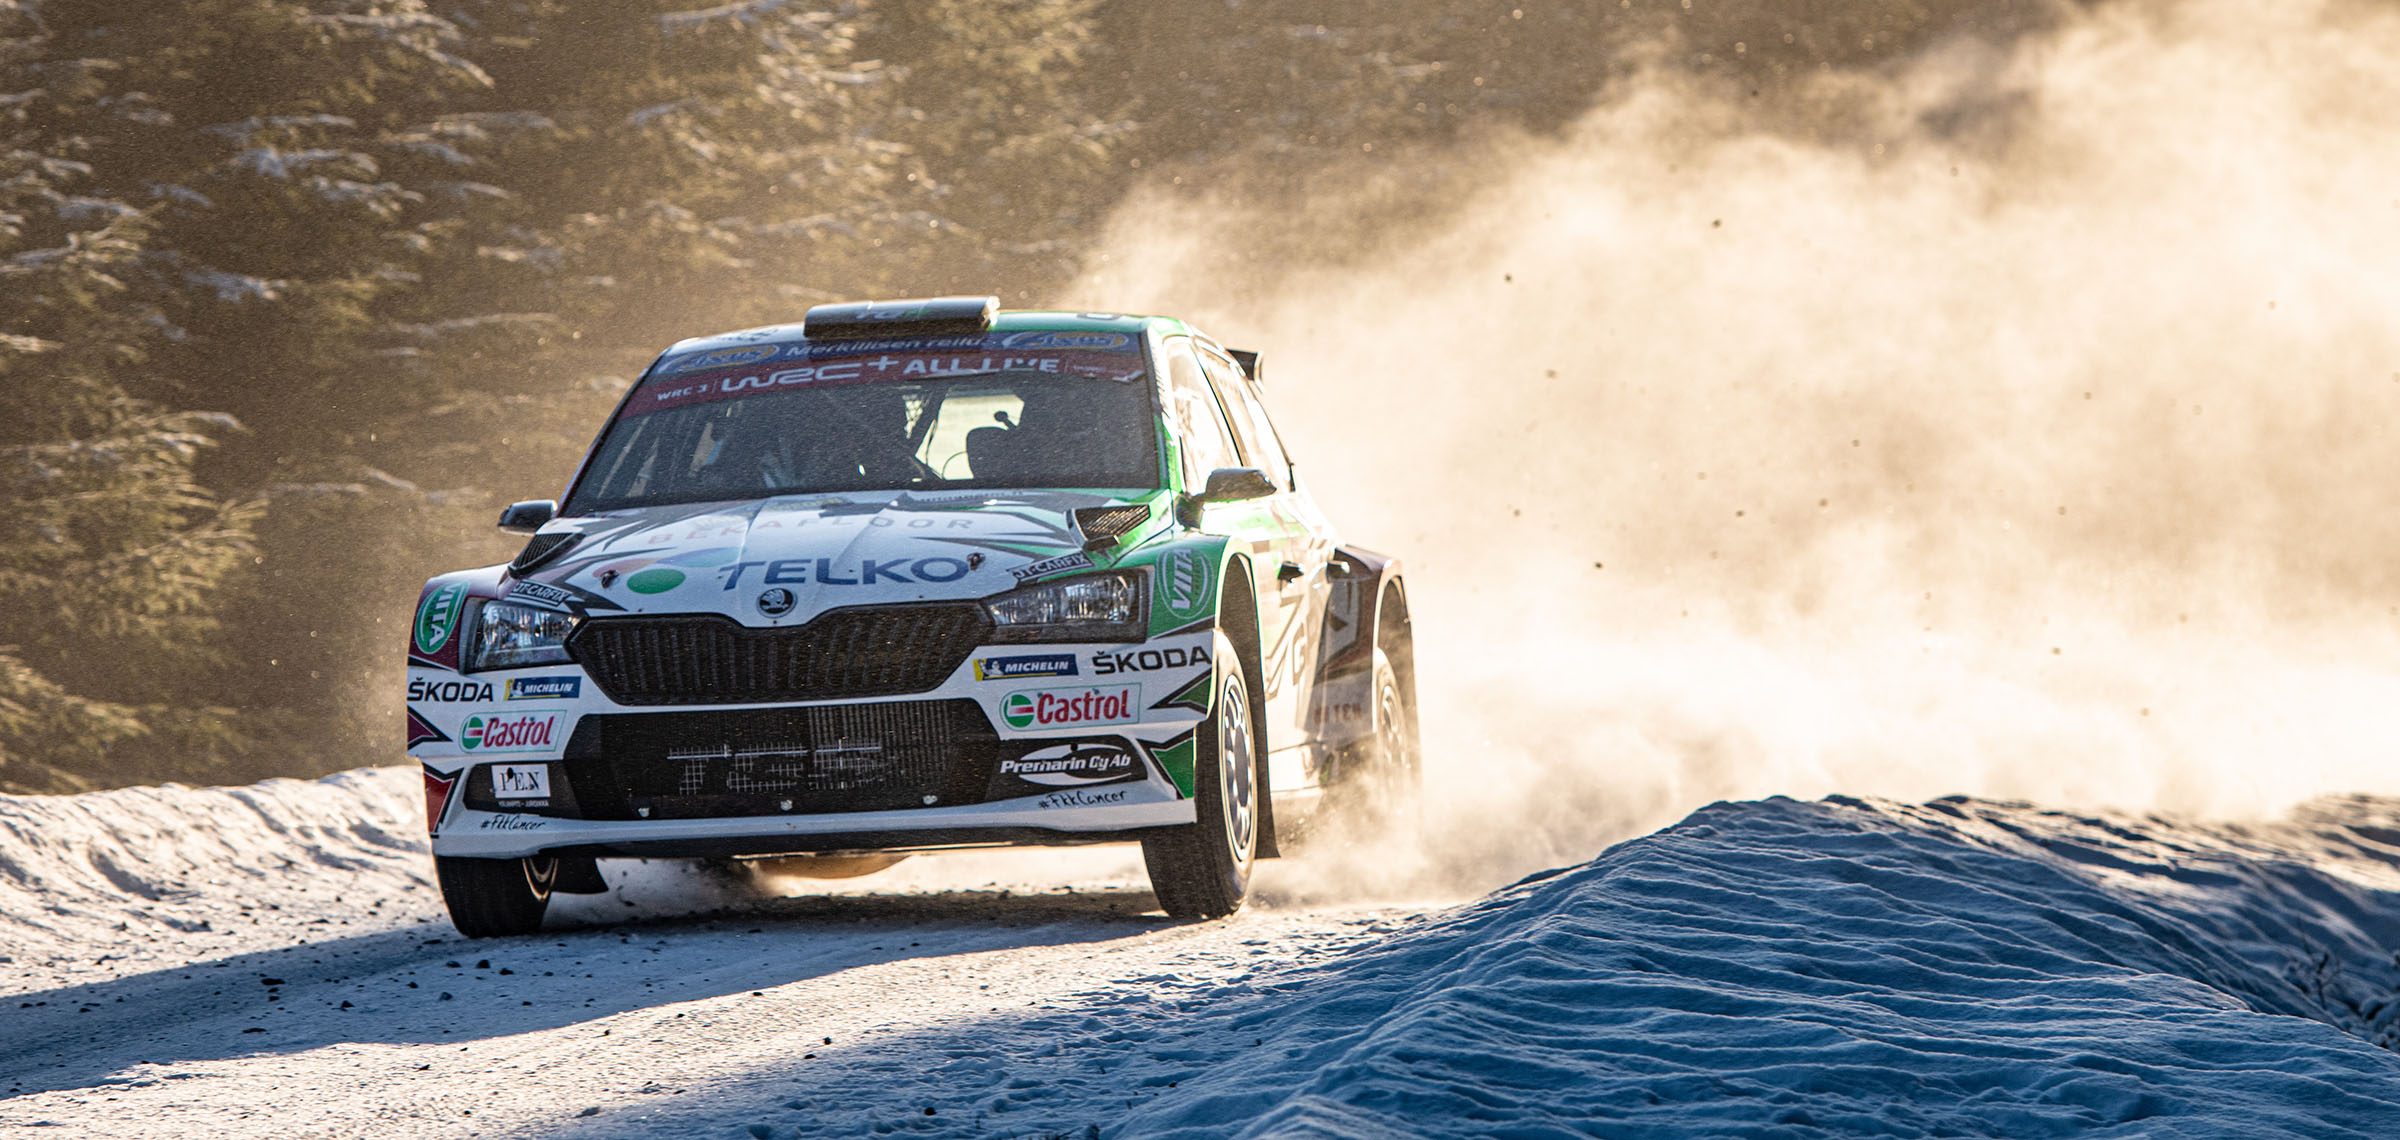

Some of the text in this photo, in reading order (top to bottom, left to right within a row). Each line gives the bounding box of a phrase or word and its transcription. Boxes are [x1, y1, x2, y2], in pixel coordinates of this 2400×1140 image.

[657, 386, 693, 400] WRC
[720, 557, 971, 591] TELKO
[1013, 553, 1090, 578] JT-CARFIX
[1005, 660, 1069, 673] MICHELIN
[1092, 646, 1212, 675] ŠKODA
[408, 677, 494, 702] ŠKODA
[523, 682, 575, 694] MICHELIN
[1037, 689, 1131, 724] Castrol
[483, 715, 555, 748] Castrol
[1000, 757, 1086, 774] Premarin
[1109, 754, 1131, 767] Ab
